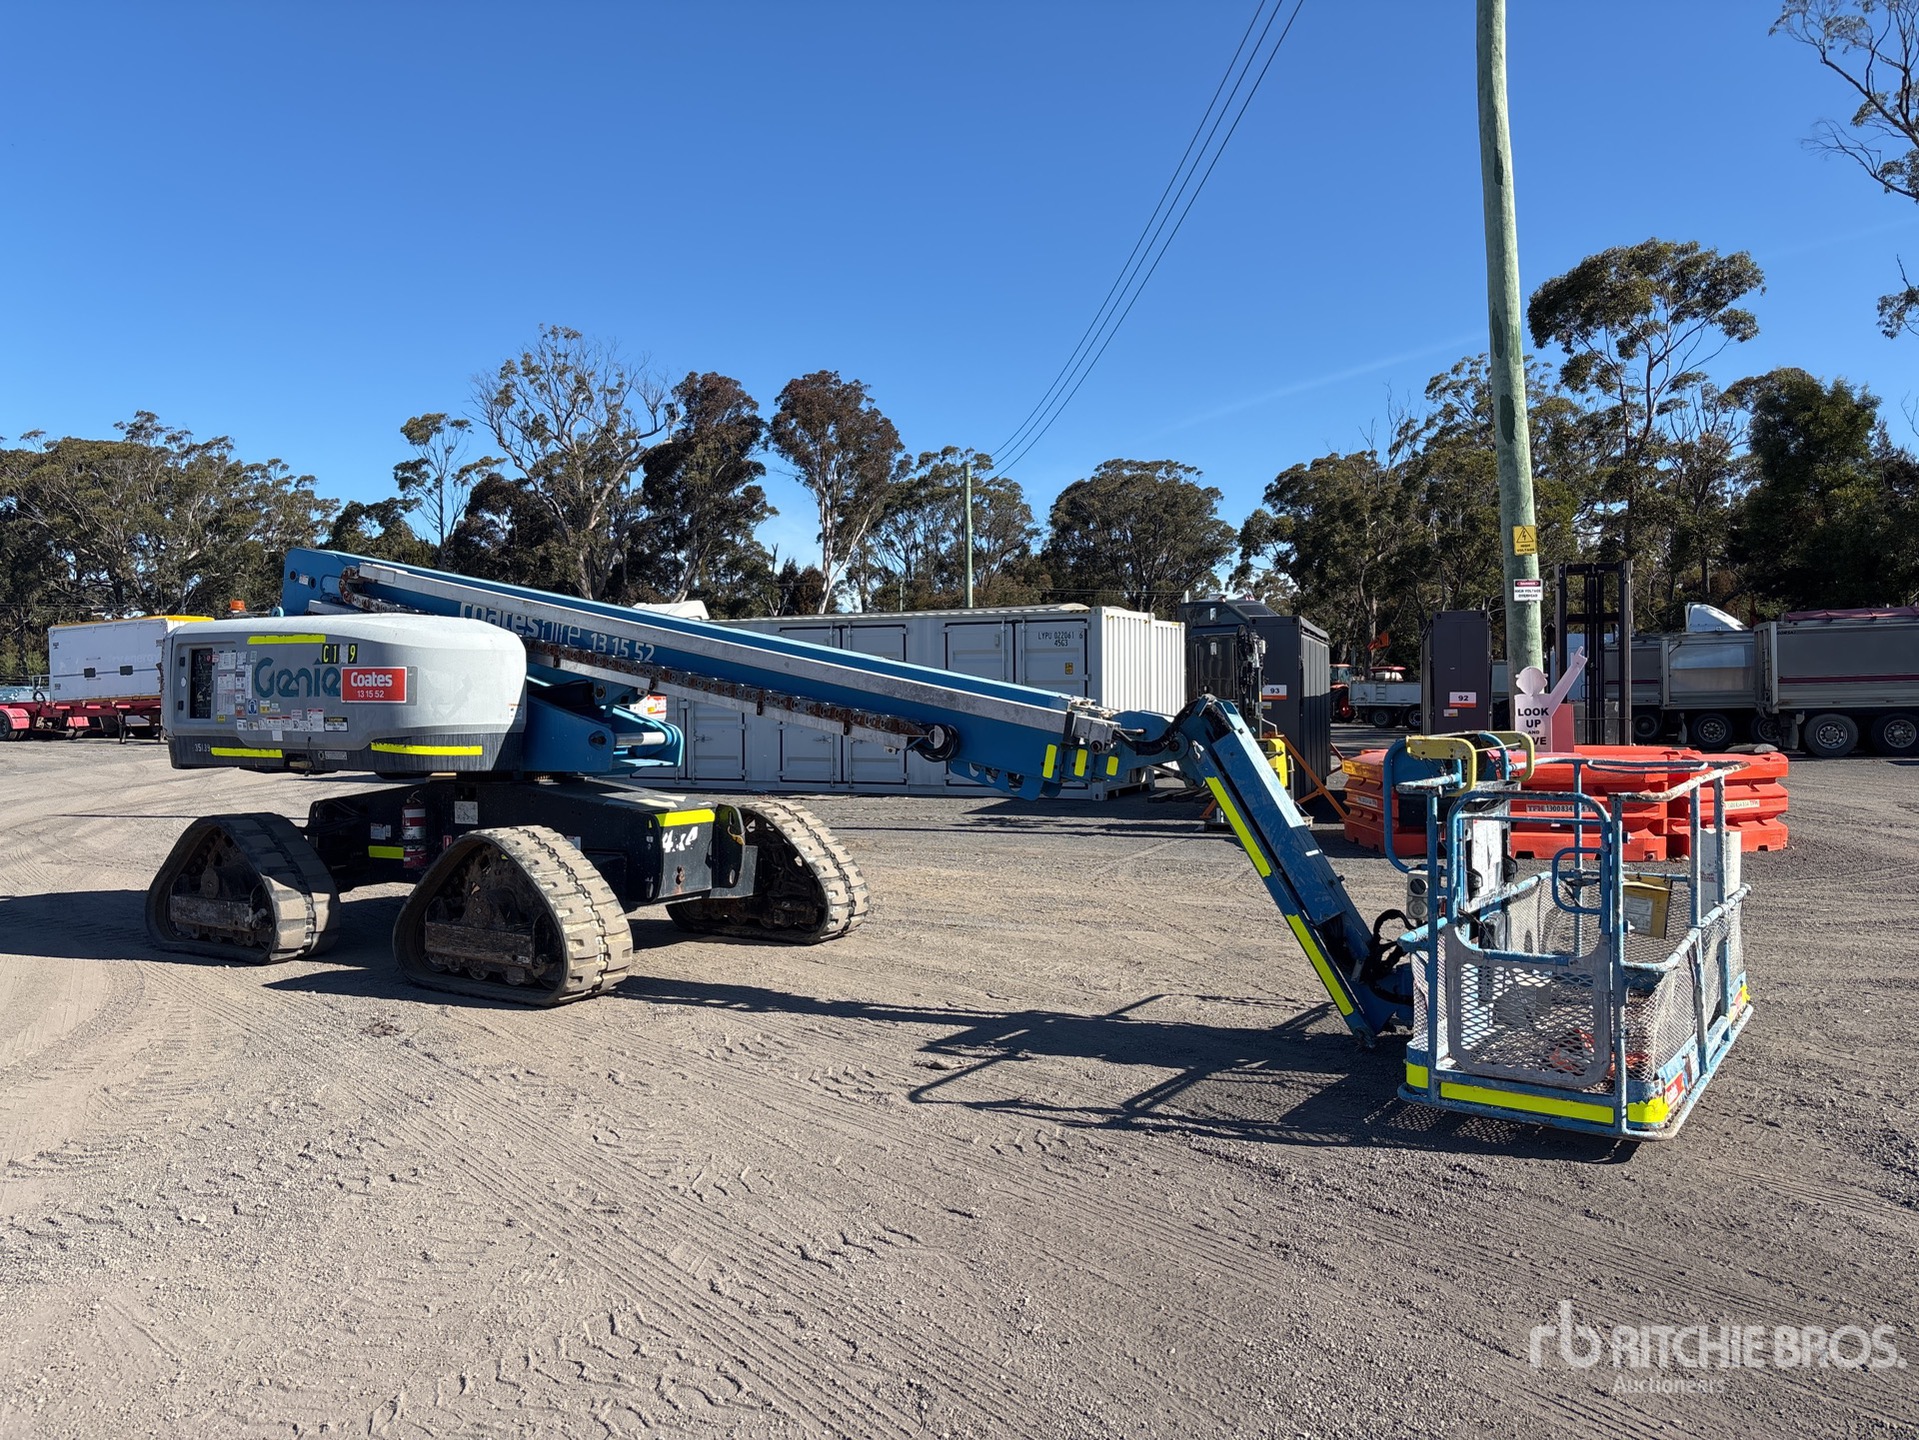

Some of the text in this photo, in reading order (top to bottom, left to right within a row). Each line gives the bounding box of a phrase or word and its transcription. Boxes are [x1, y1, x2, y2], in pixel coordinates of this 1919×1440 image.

[1038, 632, 1052, 640] LYPU
[591, 633, 607, 653] 13
[612, 637, 629, 658] 15
[634, 642, 655, 663] 52
[254, 657, 341, 698] Genie
[350, 671, 393, 688] Coates
[357, 690, 384, 698] 13 15 52
[1517, 707, 1549, 716] LOOK
[1526, 719, 1541, 728] UP
[1532, 737, 1547, 745] VE
[1546, 804, 1560, 812] 1300
[1561, 804, 1573, 812] 834
